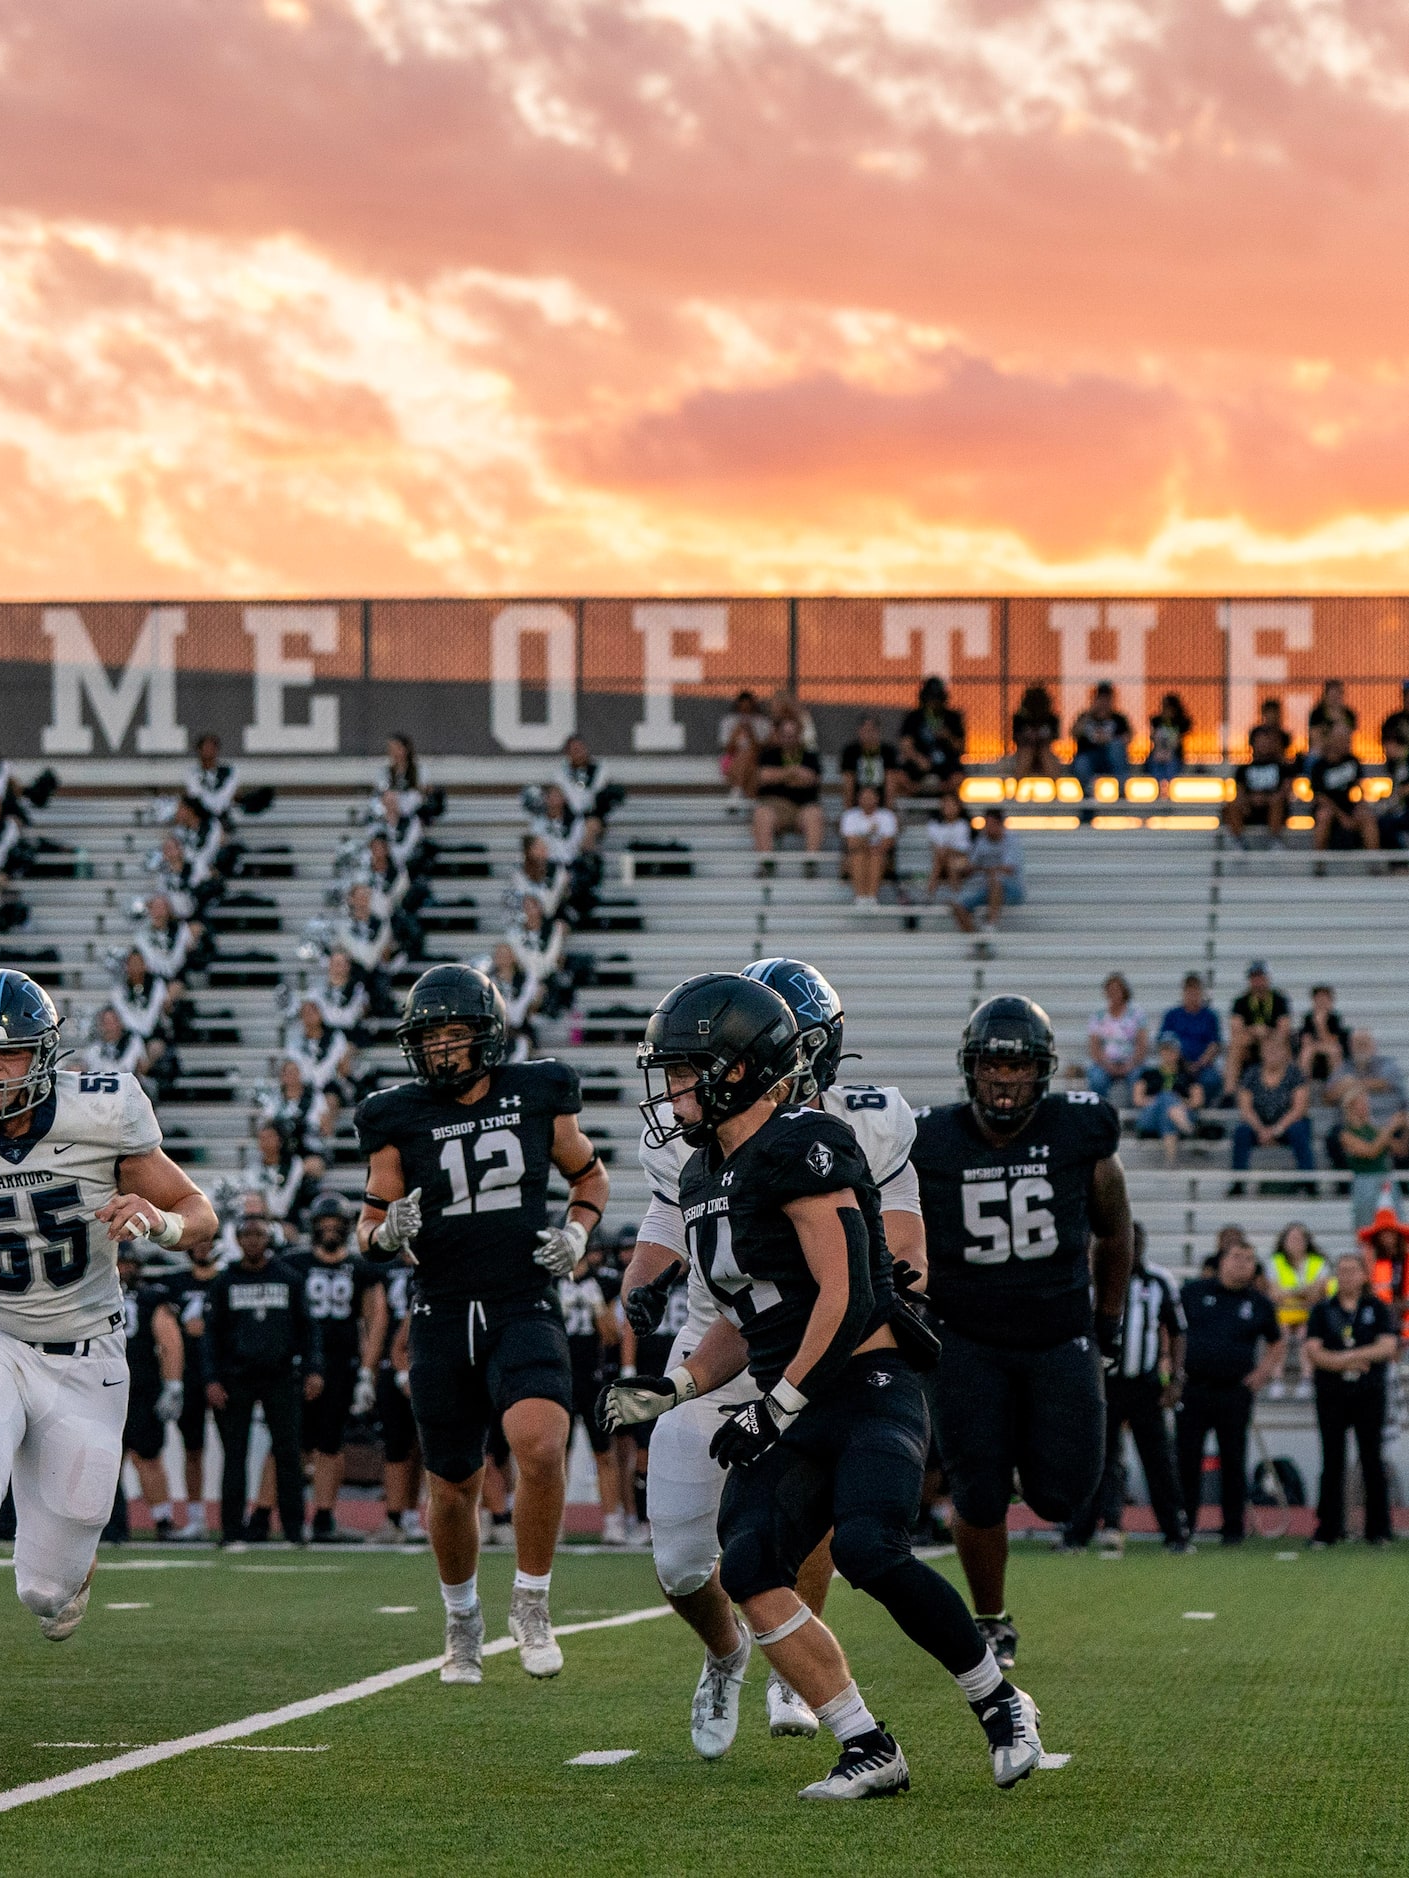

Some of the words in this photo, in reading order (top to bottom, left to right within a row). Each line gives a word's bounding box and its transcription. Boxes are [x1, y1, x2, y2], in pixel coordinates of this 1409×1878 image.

[490, 604, 730, 752] OF
[883, 602, 1314, 750] THE
[431, 1121, 476, 1141] BISHOP
[480, 1113, 521, 1131] LYNCH
[439, 1129, 526, 1216] 12
[963, 1166, 1005, 1180] BISHOP
[1008, 1163, 1048, 1178] LYNCH
[707, 1196, 730, 1214] LYNCH
[961, 1177, 1060, 1266] 56
[747, 1403, 760, 1435] adidas
